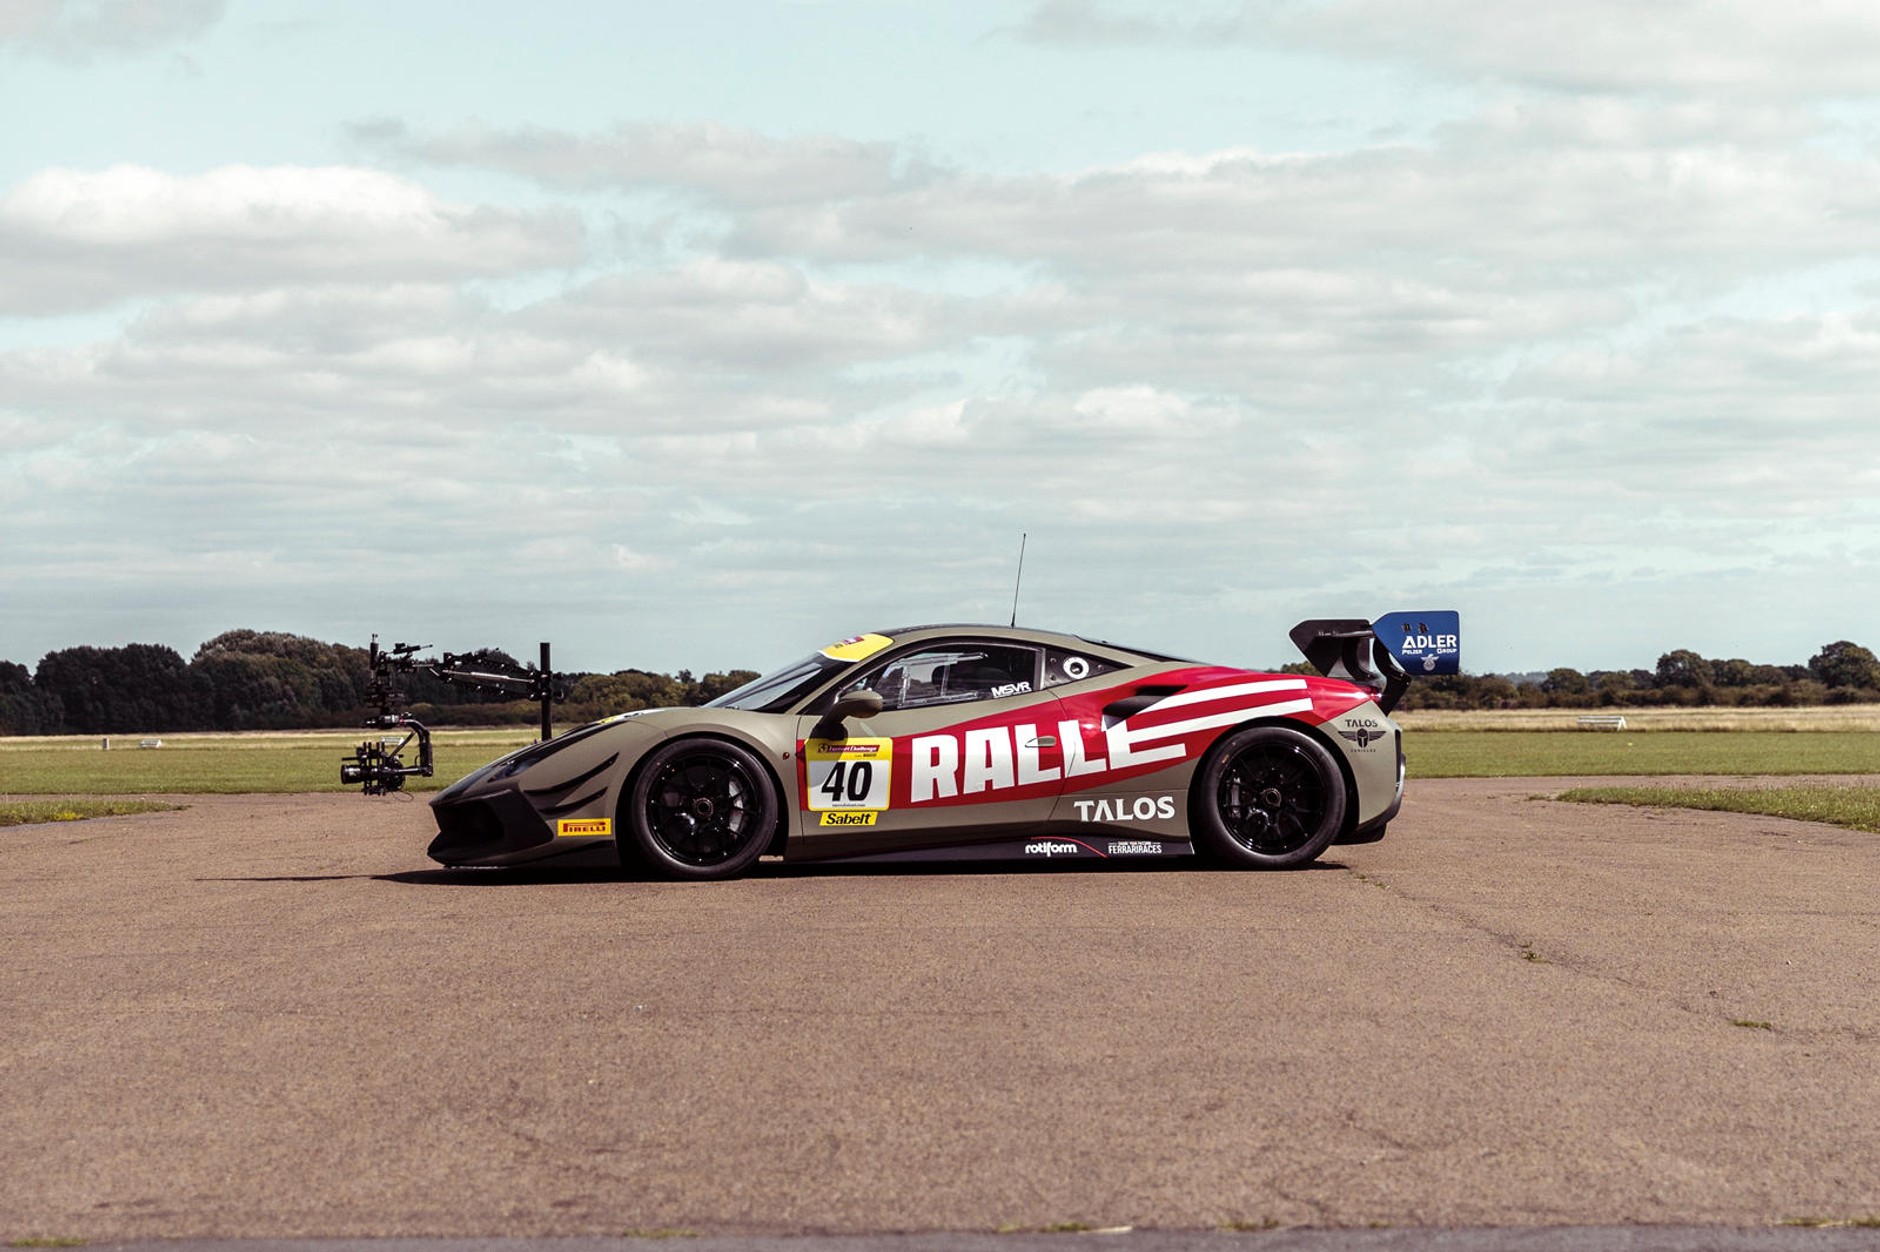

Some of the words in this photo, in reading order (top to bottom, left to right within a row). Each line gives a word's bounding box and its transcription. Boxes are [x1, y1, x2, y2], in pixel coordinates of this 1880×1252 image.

[1402, 635, 1457, 649] ADLER
[991, 682, 1031, 697] MSVR
[1345, 718, 1378, 728] TALOS
[821, 761, 873, 802] 40
[1073, 796, 1176, 822] TALOS
[826, 812, 872, 825] Sabelt
[563, 821, 606, 832] PIRELLI
[1025, 841, 1078, 857] rotiform
